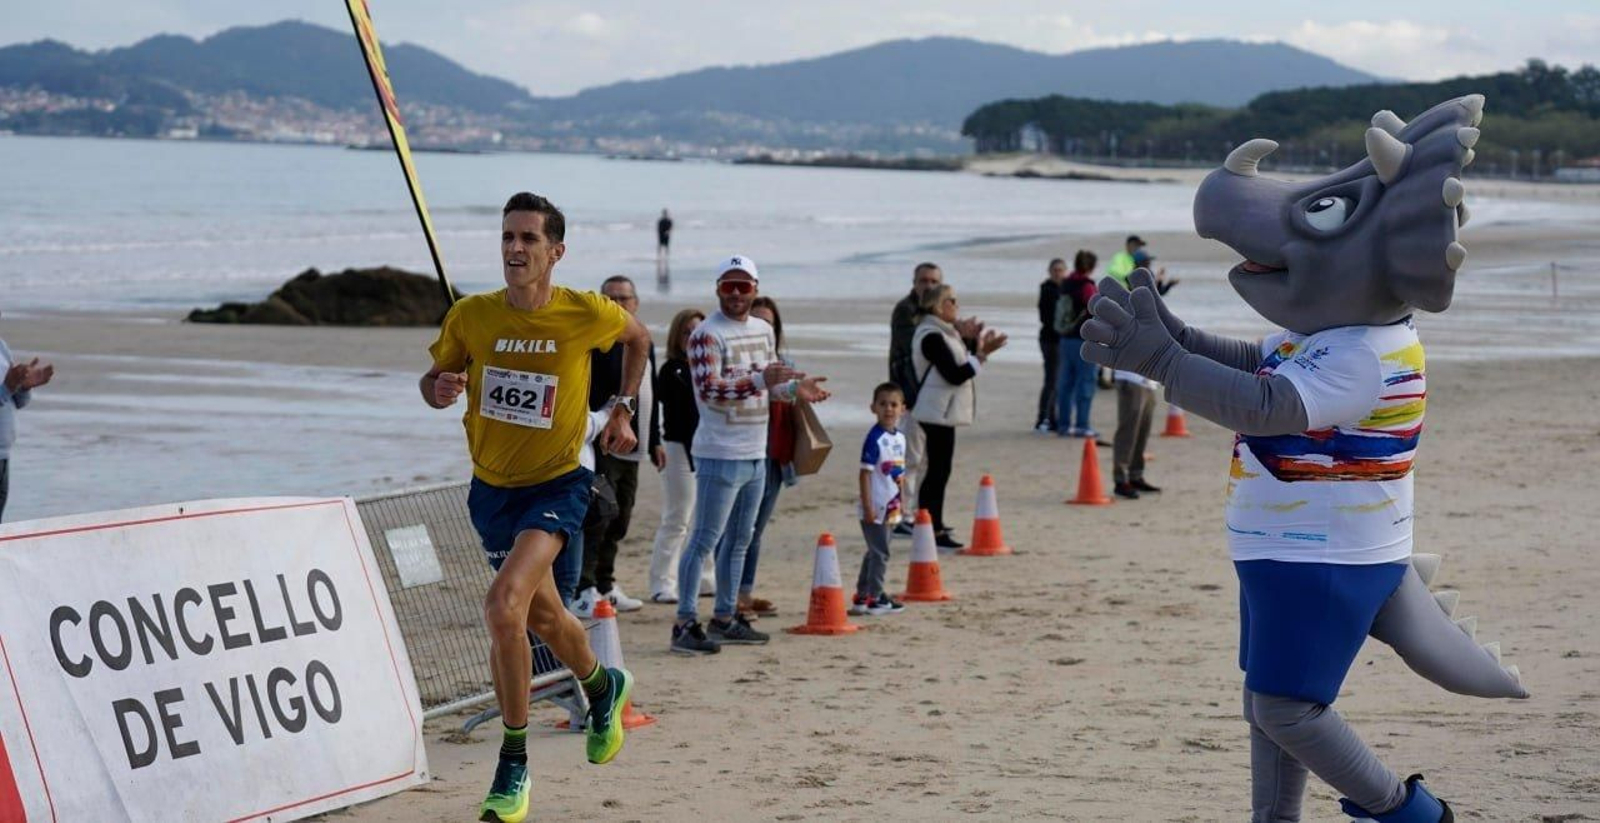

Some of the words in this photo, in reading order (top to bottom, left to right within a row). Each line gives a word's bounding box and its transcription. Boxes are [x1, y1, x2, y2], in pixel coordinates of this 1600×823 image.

[494, 338, 557, 353] BIKILA
[489, 386, 537, 410] 462
[49, 568, 343, 678] CONCELLO
[112, 687, 201, 769] DE
[204, 660, 343, 745] VIGO
